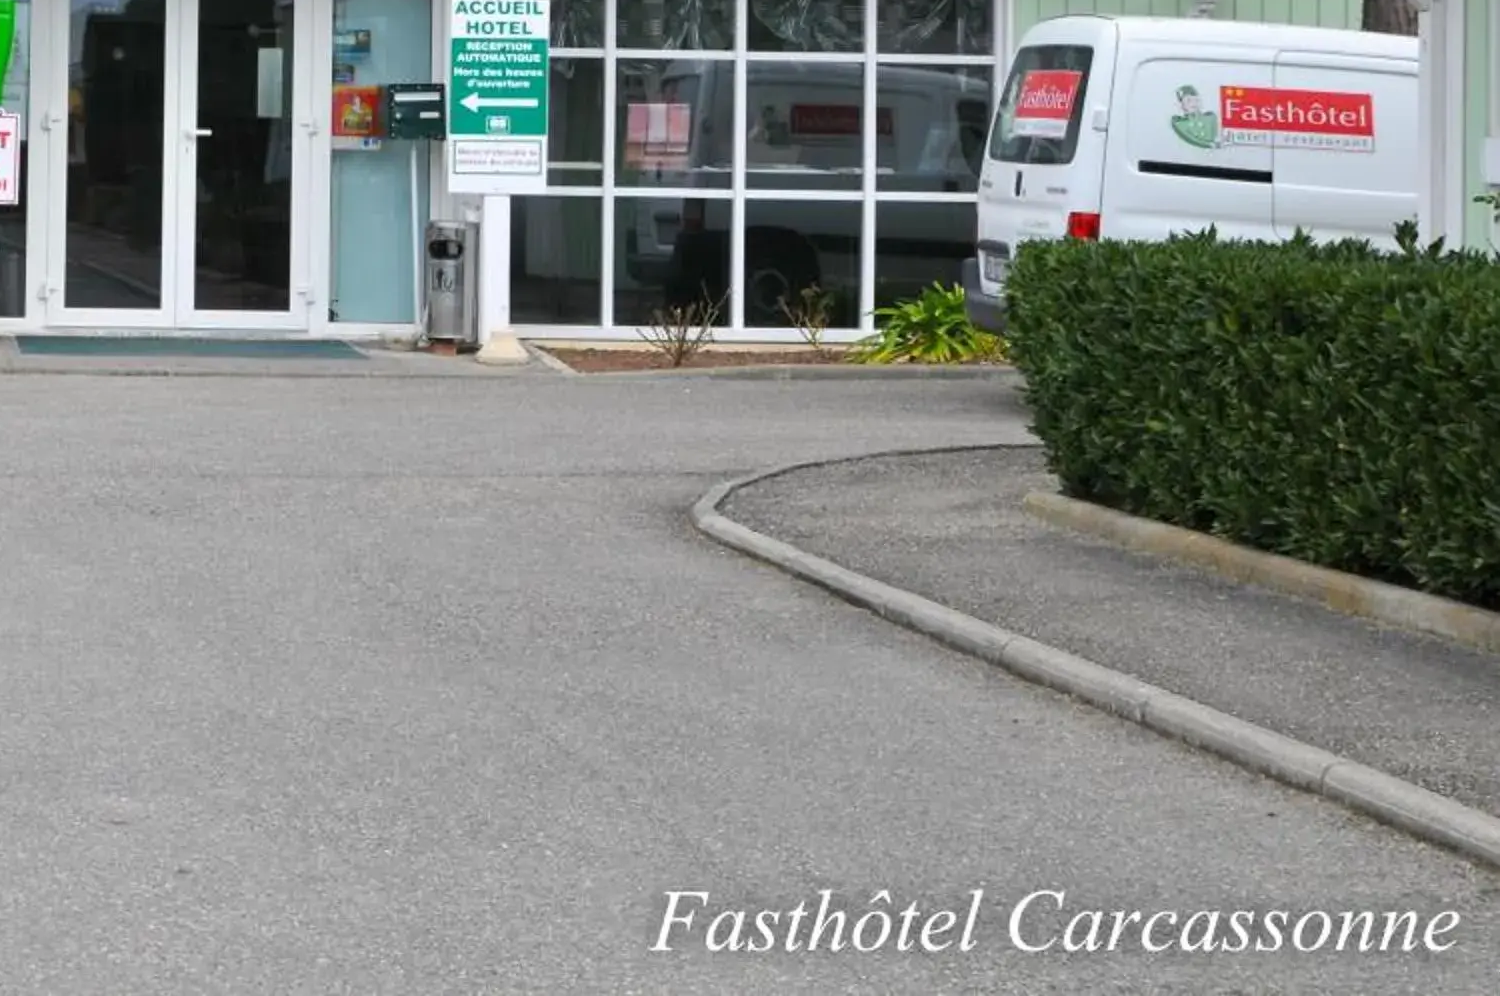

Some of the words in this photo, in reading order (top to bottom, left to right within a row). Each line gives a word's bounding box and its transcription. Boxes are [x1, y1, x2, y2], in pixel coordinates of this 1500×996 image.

[455, 0, 544, 15] ACCUEIL
[466, 21, 533, 35] HOTEL
[456, 52, 542, 63] AUTOMATIQUE
[482, 67, 503, 77] des
[505, 67, 544, 77] heures
[1224, 98, 1367, 128] Fasthôtel
